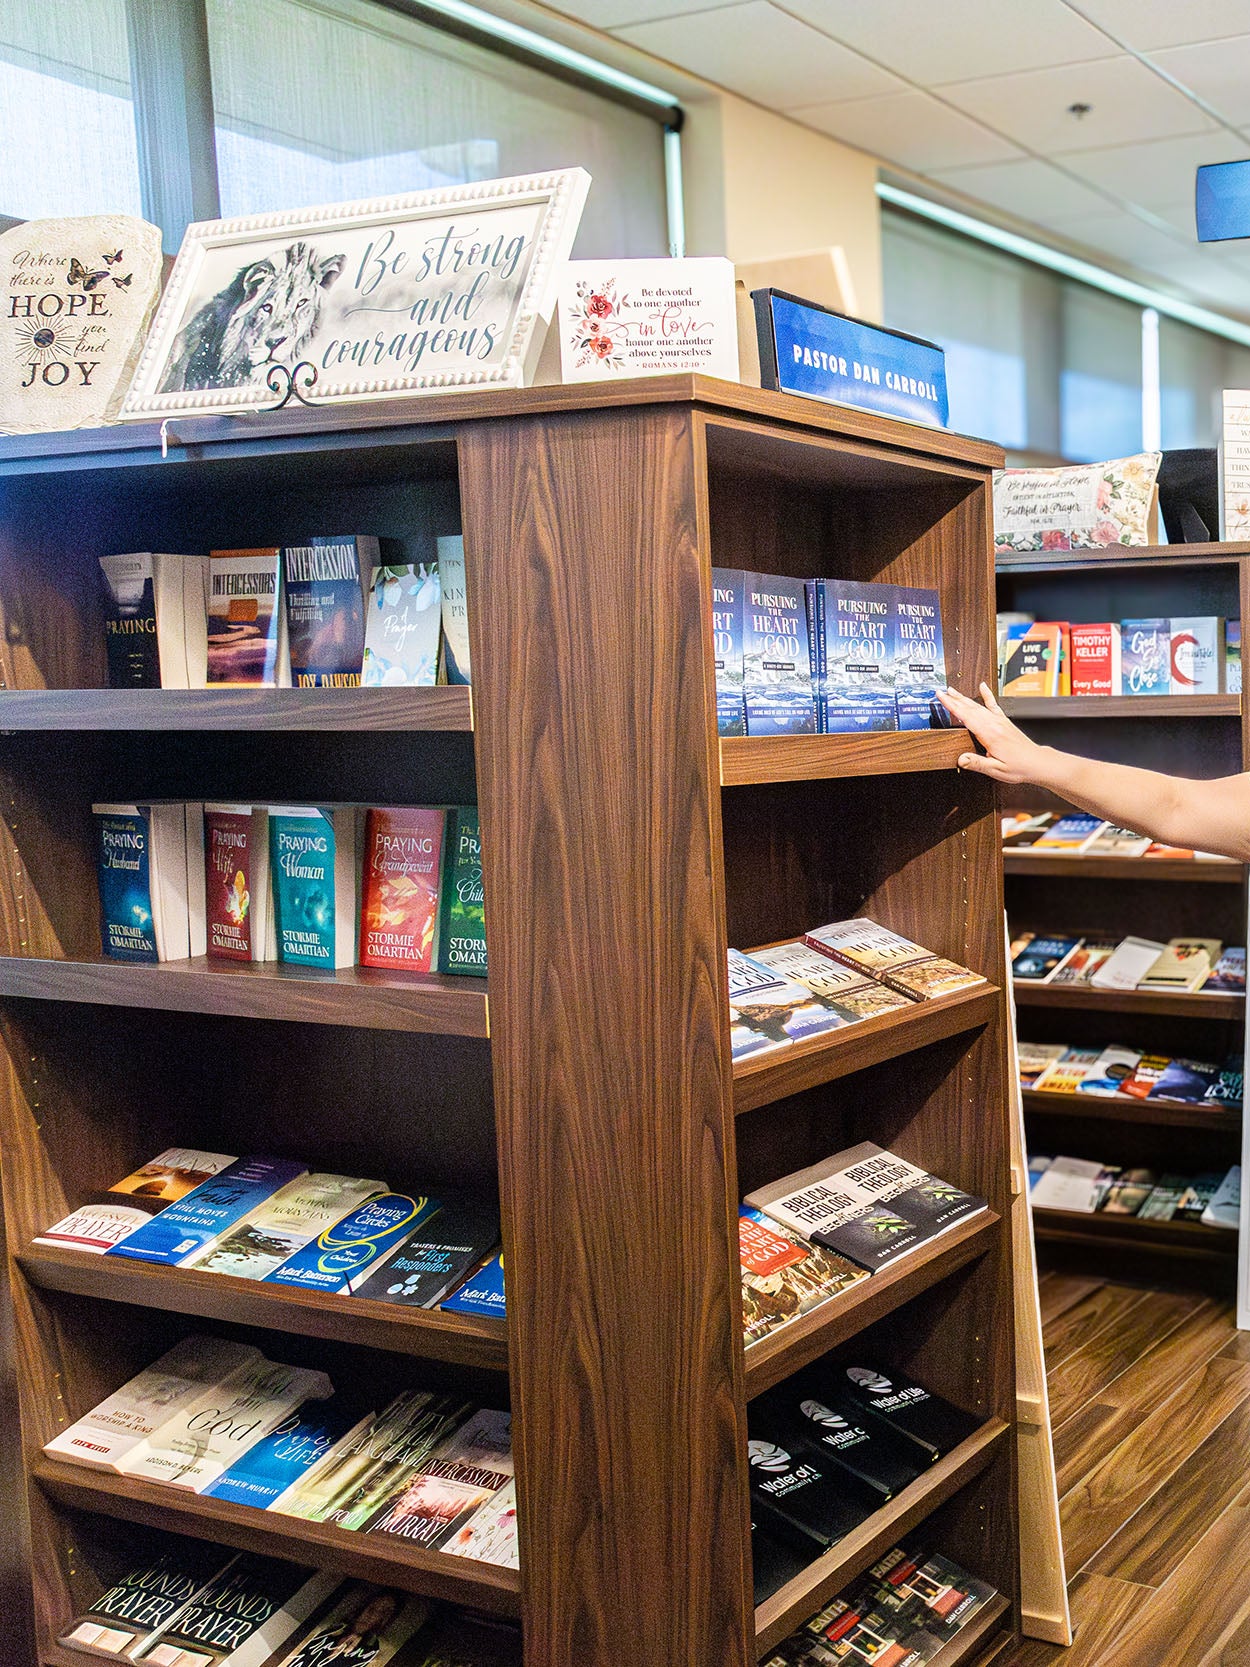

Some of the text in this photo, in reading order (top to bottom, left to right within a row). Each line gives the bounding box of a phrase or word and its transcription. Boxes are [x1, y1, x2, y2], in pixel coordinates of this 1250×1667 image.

[12, 250, 67, 269] Where
[355, 226, 531, 296] Be strong
[10, 273, 44, 287] there
[344, 271, 490, 325] and
[641, 288, 692, 297] Be devoted
[8, 294, 113, 318] HOPE,
[633, 299, 643, 308] to
[663, 299, 702, 308] another
[73, 334, 109, 357] find
[322, 324, 503, 372] courageous
[626, 338, 653, 347] honor
[675, 338, 713, 346] another
[628, 348, 712, 359] above yourselves
[22, 362, 100, 387] JOY
[792, 344, 938, 402] PASTOR DAN CARROLL
[285, 544, 360, 582] INTERCESSION,
[212, 572, 276, 595] INTERCESSORS
[751, 593, 797, 609] PURSUING
[838, 599, 887, 614] PURSUING
[898, 604, 934, 617] PURSUING
[768, 608, 782, 616] THE
[106, 618, 156, 635] PRAYING
[753, 615, 798, 634] HEART
[838, 620, 886, 638] HEART
[900, 623, 935, 640] HEART
[763, 635, 799, 657] GOD
[848, 640, 885, 659] GOD
[910, 640, 937, 659] GOD
[1023, 644, 1040, 653] LIVE
[1072, 635, 1111, 646] TIMOTHY
[1131, 630, 1157, 654] God
[1024, 656, 1037, 664] NO
[1076, 647, 1108, 657] KELLER
[1020, 666, 1039, 675] LIES
[1129, 665, 1159, 692] Close
[297, 674, 316, 687] JOY
[1073, 680, 1111, 689] Every Good
[103, 830, 144, 849] PRAYING
[212, 829, 246, 848] PRAYING
[279, 833, 327, 853] PRAYING
[376, 833, 433, 853] PRAYING
[102, 848, 144, 870] Husband
[212, 846, 234, 884] Wife
[280, 852, 324, 879] Woman
[109, 924, 143, 938] STORMIE
[212, 923, 241, 938] STORMIE
[283, 930, 320, 944] STORMIE
[367, 932, 414, 945] STORMIE
[110, 936, 152, 950] OMARTIAN
[212, 935, 248, 950] OMARTIAN
[283, 942, 329, 957] OMARTIAN
[368, 944, 423, 960] OMARTIAN
[845, 1158, 896, 1182] BIBLICAL
[857, 1164, 914, 1194] THEOLOGY
[880, 1176, 931, 1203] BEGINNERS
[781, 1186, 838, 1213] BIBLICAL
[795, 1193, 857, 1224] THEOLOGY
[161, 1213, 216, 1227] MOUNTAINS
[172, 1204, 229, 1218] STILL MOVES
[360, 1202, 407, 1220] Praying
[818, 1205, 875, 1235] BEGINNERS
[936, 1203, 972, 1223] DAN CARROLL
[53, 1217, 132, 1242] PRAYER
[354, 1214, 391, 1228] Circles
[423, 1249, 451, 1262] First
[753, 1241, 790, 1261] GOD
[877, 1235, 917, 1258] DAN CARROLL
[276, 1266, 304, 1279] Mark
[300, 1271, 341, 1283] Batterson
[390, 1257, 453, 1273] Responders
[459, 1288, 488, 1300] Mark
[870, 1387, 926, 1409] Water of Life
[90, 1414, 125, 1428] WORSHIP
[131, 1424, 154, 1434] KING
[112, 1410, 146, 1424] HOW TO
[187, 1408, 262, 1441] God
[822, 1430, 856, 1446] Water
[837, 1434, 871, 1450] community
[274, 1446, 322, 1465] LIFE
[336, 1437, 431, 1468] LANGUAGE
[145, 1457, 171, 1468] ADDISON
[419, 1458, 508, 1490] INTERCESSION
[759, 1466, 811, 1493] Water of
[217, 1478, 279, 1496] ANDREW MURRAY
[775, 1476, 812, 1498] community
[375, 1512, 446, 1543] MURRAY
[89, 1587, 175, 1627] PRAYER
[945, 1594, 976, 1625] DAN CARROLL
[807, 1600, 850, 1634] FAITH
[172, 1607, 253, 1649] PRAYER
